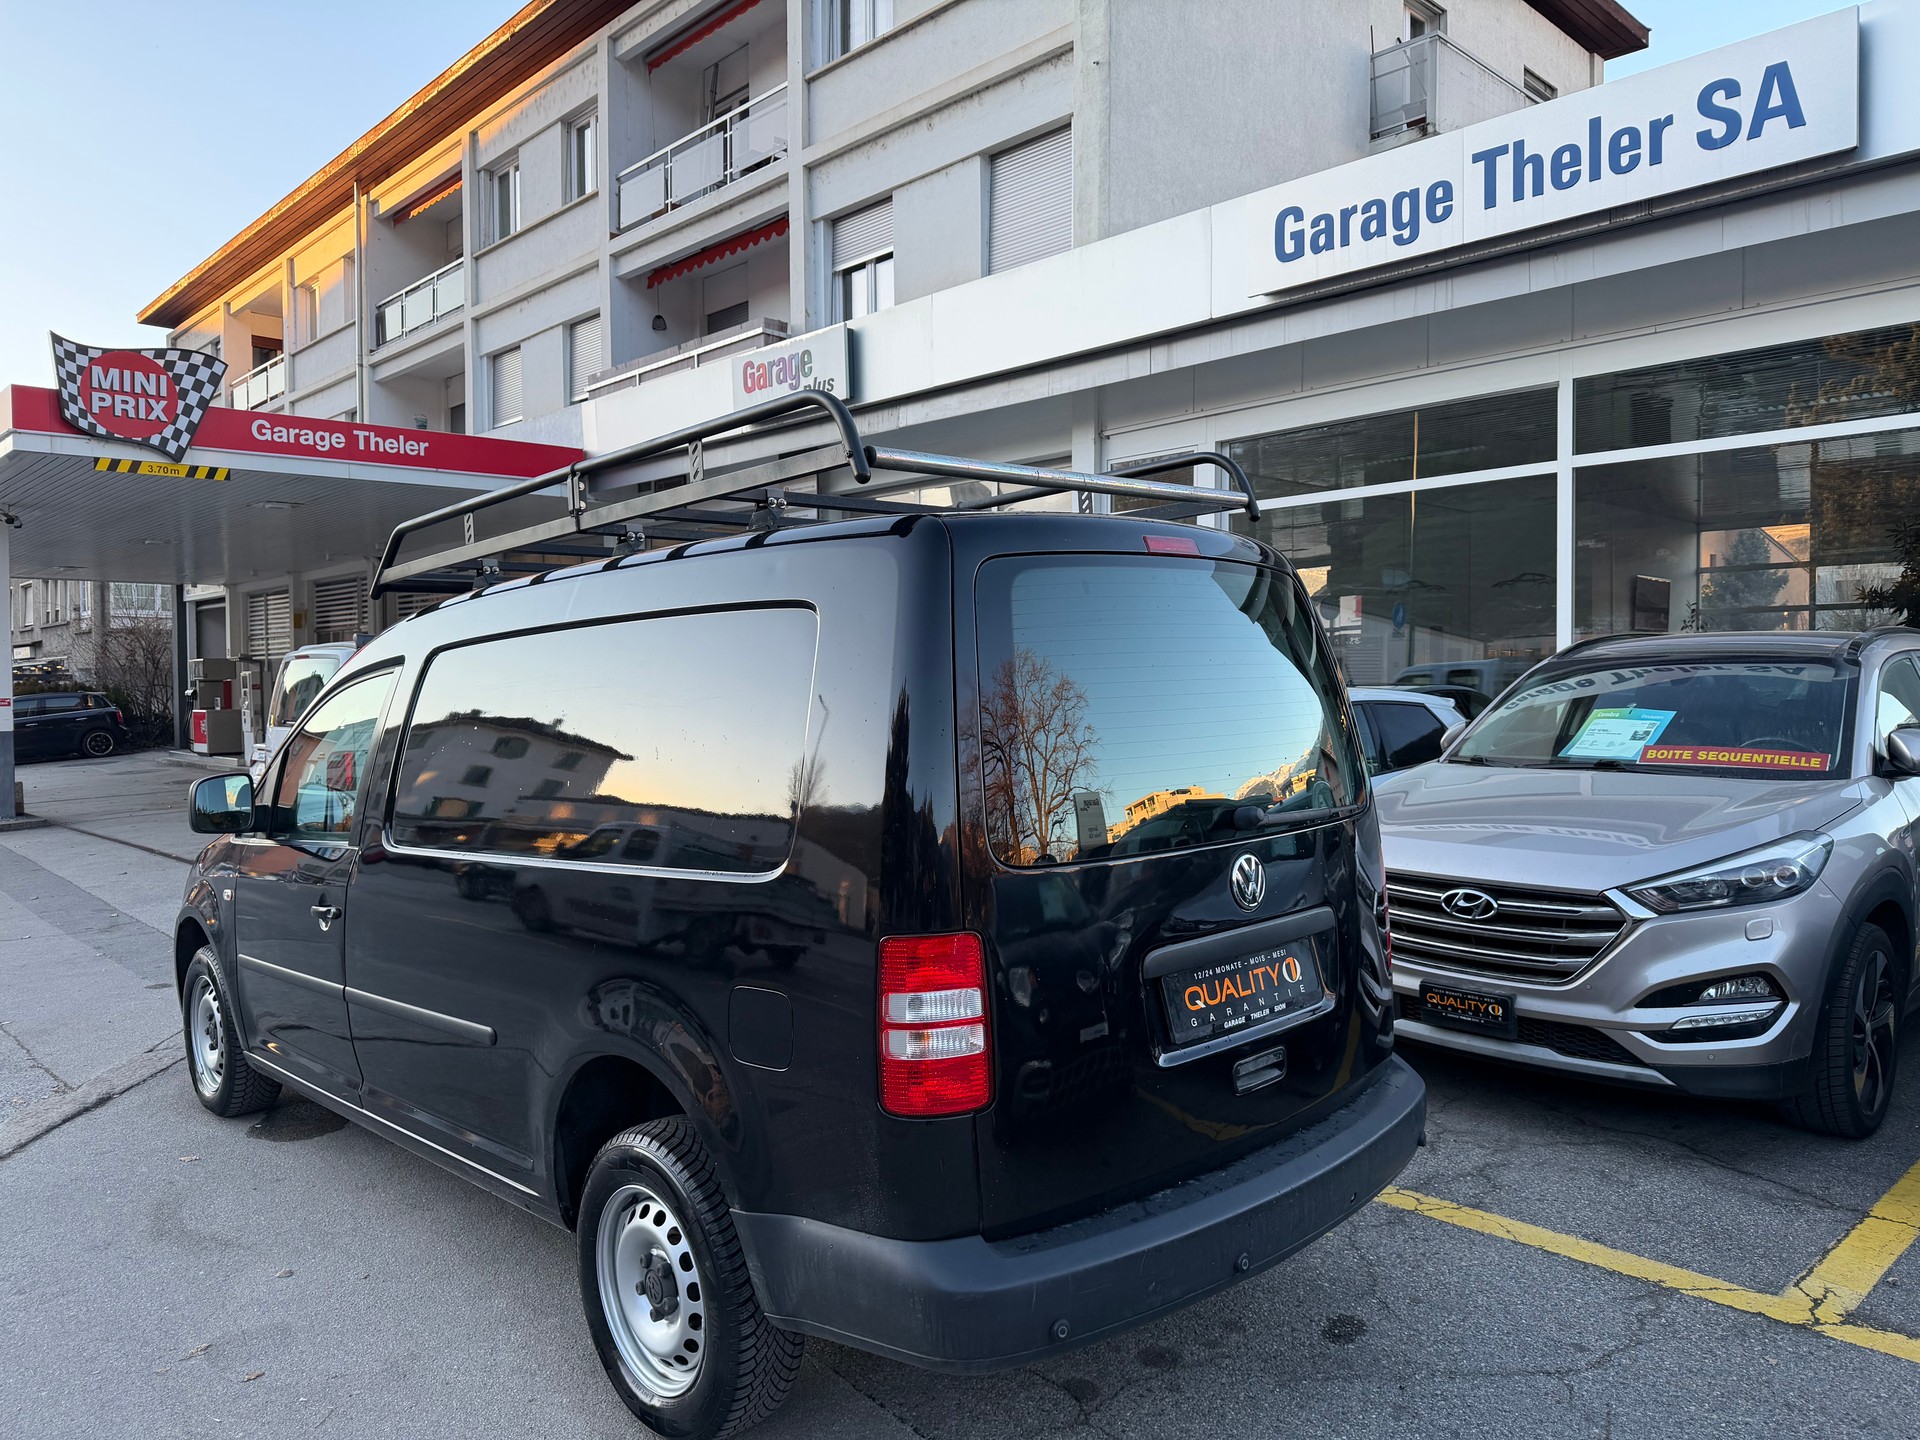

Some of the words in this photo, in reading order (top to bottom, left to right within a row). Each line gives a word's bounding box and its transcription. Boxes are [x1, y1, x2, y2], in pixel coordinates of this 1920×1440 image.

[1275, 180, 1454, 263] Garage
[1472, 114, 1674, 211] Theler
[1696, 60, 1807, 152] SA
[91, 365, 168, 397] MINI
[743, 349, 813, 394] Garage
[91, 392, 169, 422] PRIX
[251, 419, 346, 451] Garage
[353, 430, 430, 457] Theler
[1646, 749, 1694, 760] BOITE
[1697, 751, 1822, 768] SEQUENTIELLE
[1194, 969, 1213, 980] 12/24
[1215, 961, 1242, 974] MONATE
[1249, 954, 1266, 965] MOIS
[1272, 949, 1287, 959] MESI
[1184, 962, 1280, 1011] QUALITY
[1191, 984, 1306, 1027] GARANTIE
[1224, 1016, 1246, 1029] GARAGE
[1250, 1008, 1270, 1021] THELER
[1274, 1002, 1287, 1013] SION
[1426, 993, 1488, 1013] QUALITY
